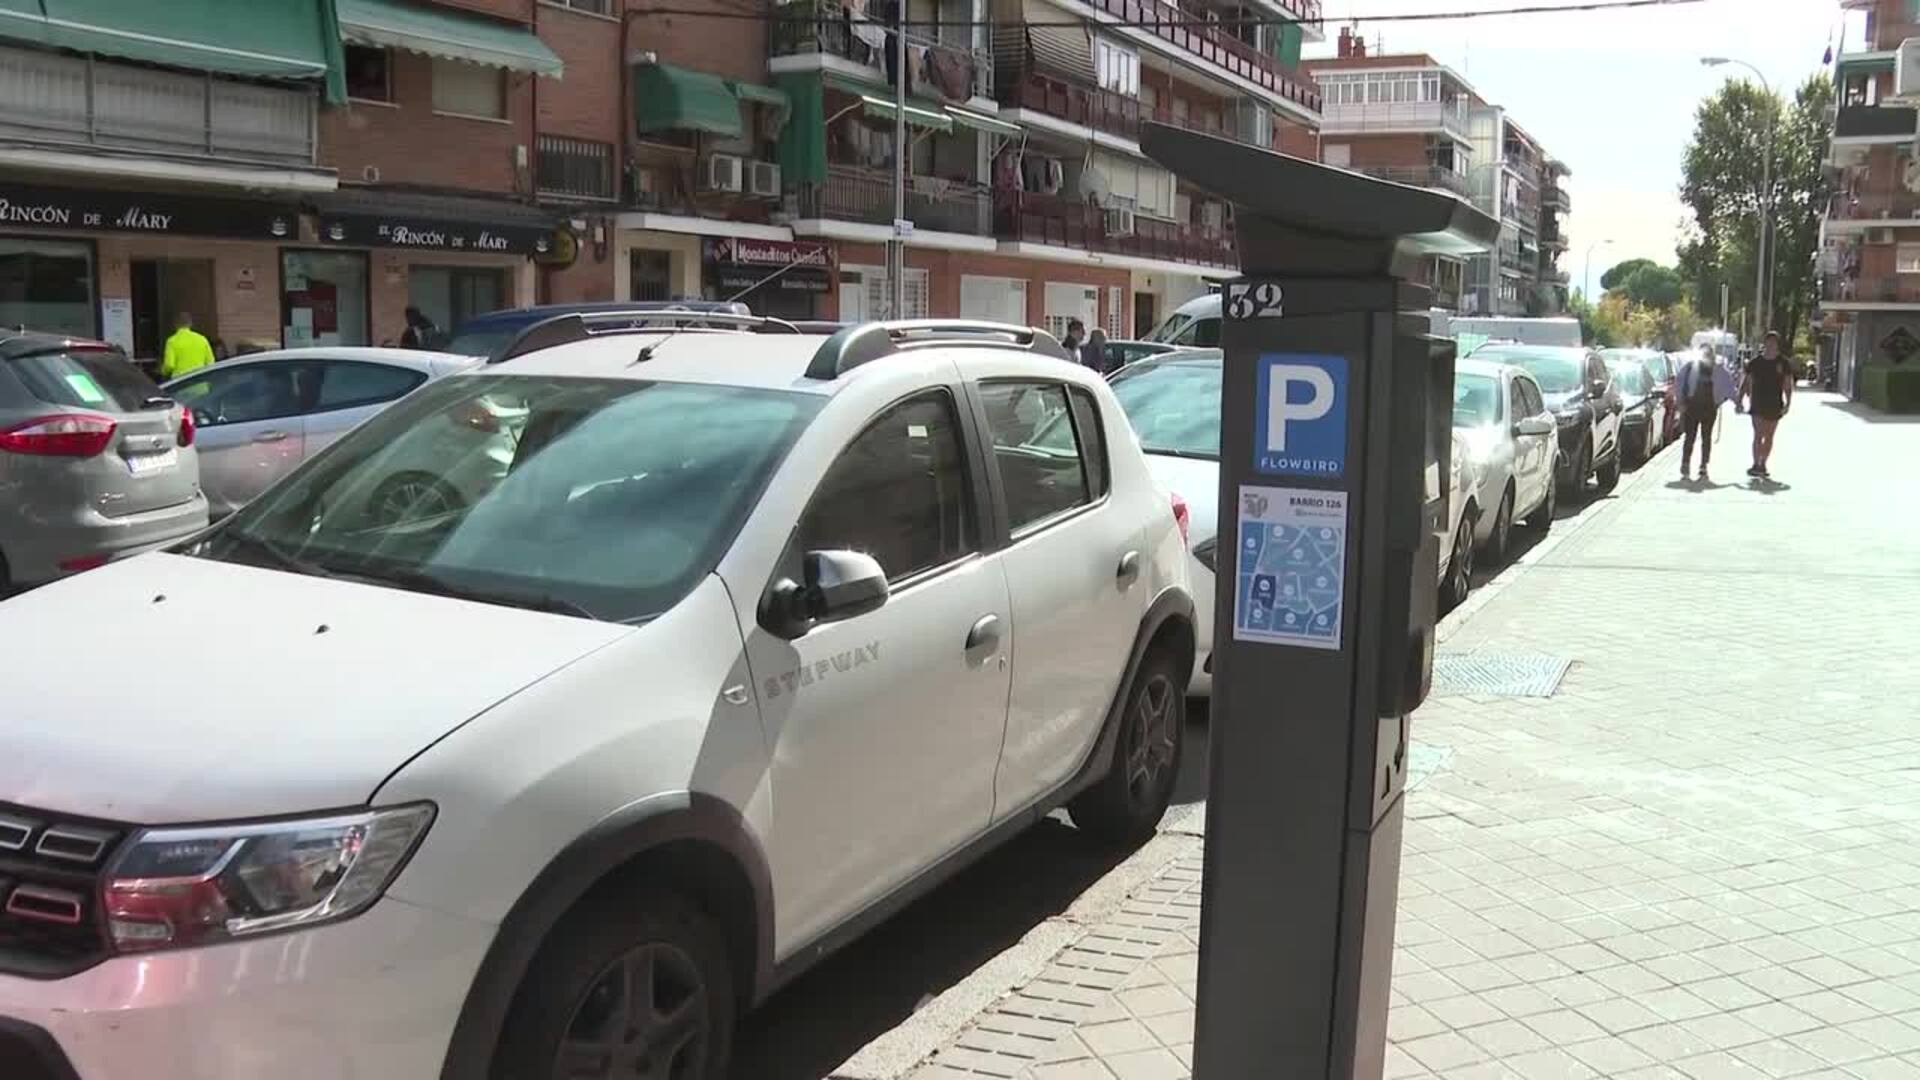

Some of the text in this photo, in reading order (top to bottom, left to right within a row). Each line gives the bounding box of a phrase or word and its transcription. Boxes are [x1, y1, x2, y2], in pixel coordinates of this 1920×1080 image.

[83, 212, 101, 225] DE
[116, 207, 172, 229] MARY
[392, 226, 445, 246] RINCÓN
[452, 236, 464, 247] DE
[473, 231, 508, 249] MARY
[1229, 283, 1283, 319] 32
[1267, 363, 1335, 452] P
[1260, 457, 1338, 472] FLOWBIRD
[764, 640, 880, 698] STEPWAY
